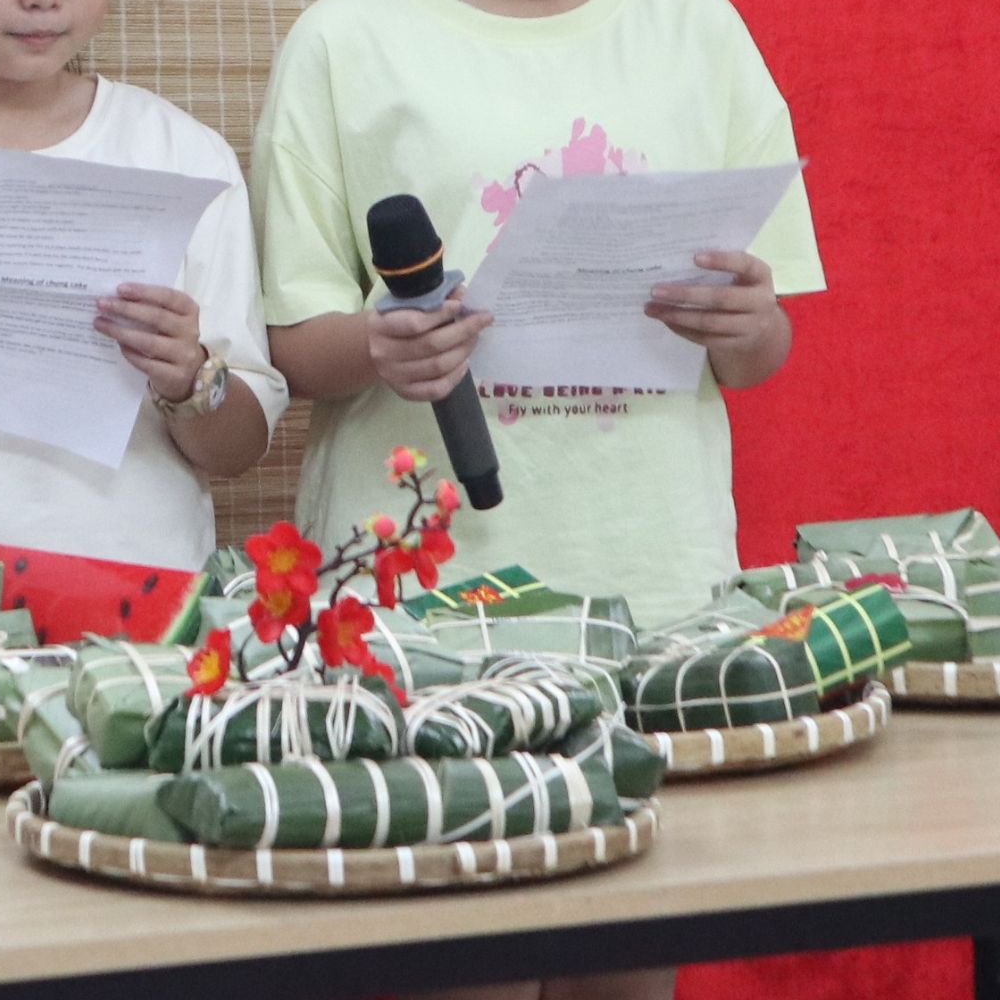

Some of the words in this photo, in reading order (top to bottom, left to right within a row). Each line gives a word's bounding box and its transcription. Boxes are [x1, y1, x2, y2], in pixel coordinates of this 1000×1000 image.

[532, 403, 561, 416] with
[565, 404, 591, 418] your
[594, 401, 629, 415] heart
